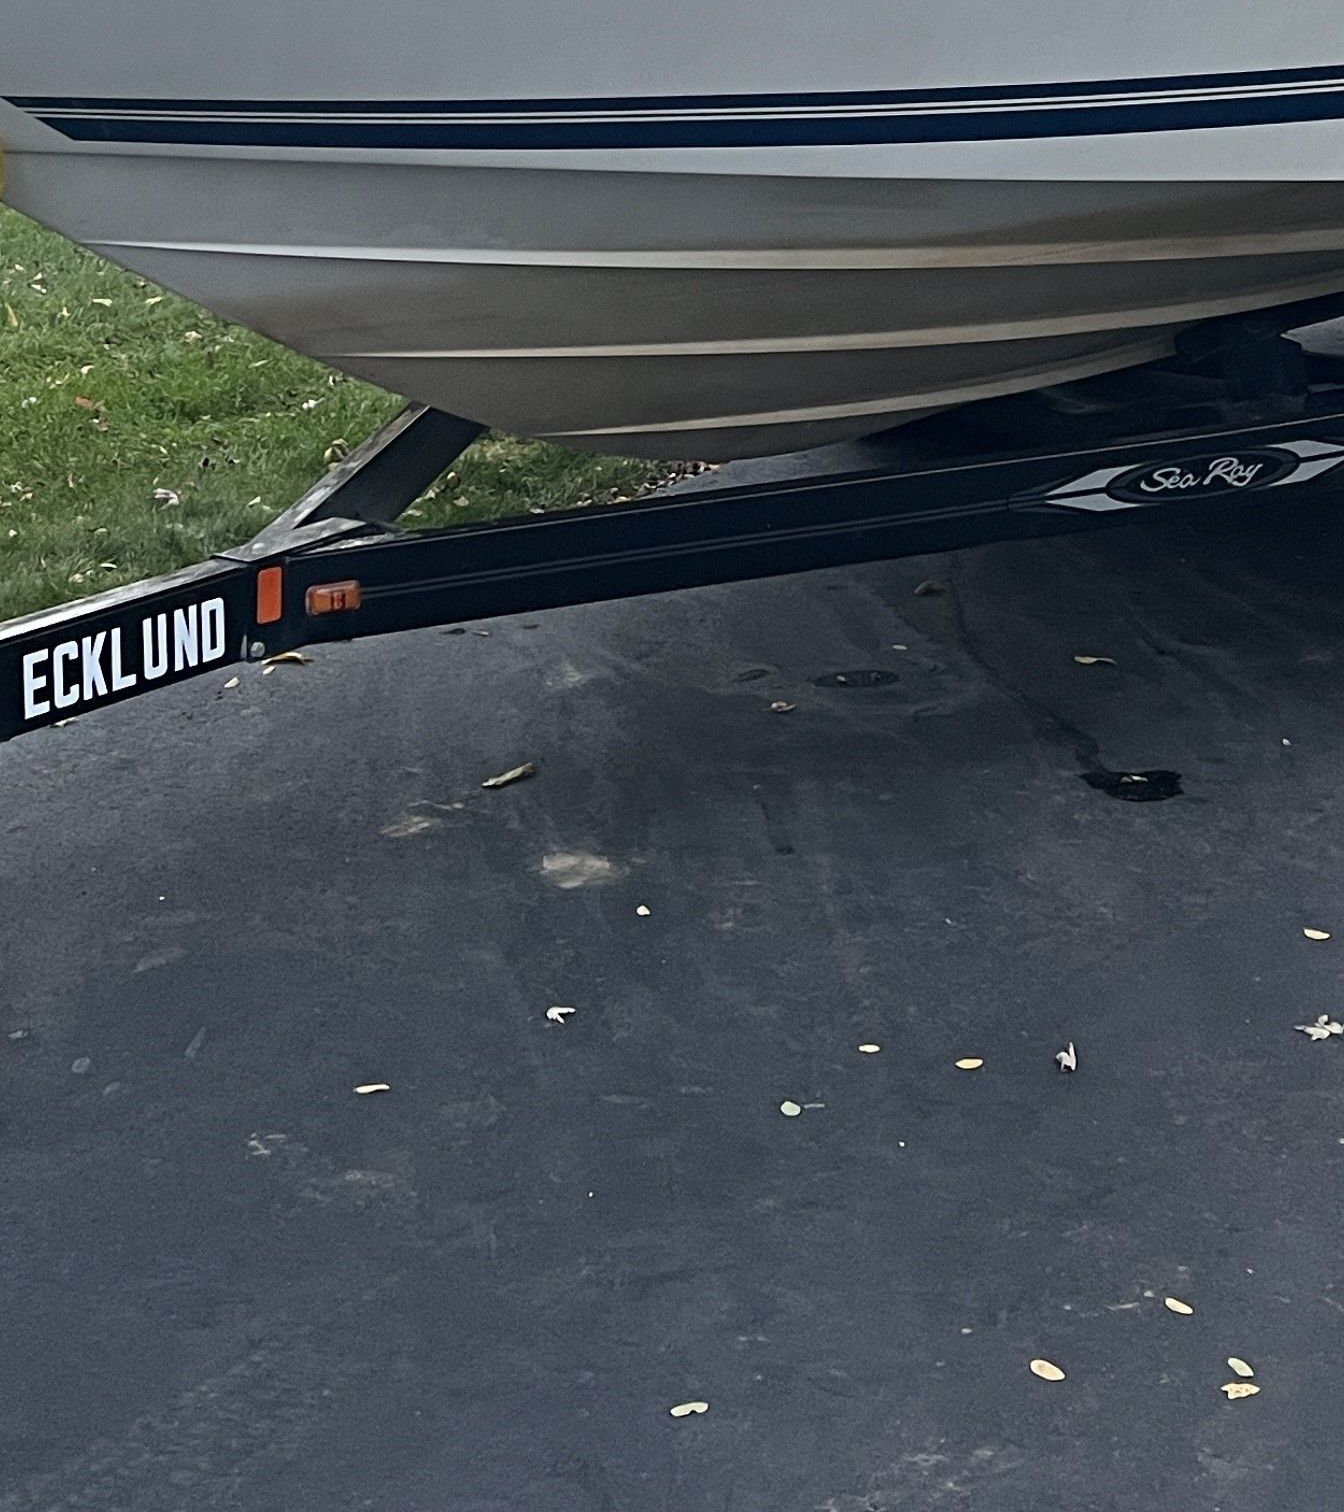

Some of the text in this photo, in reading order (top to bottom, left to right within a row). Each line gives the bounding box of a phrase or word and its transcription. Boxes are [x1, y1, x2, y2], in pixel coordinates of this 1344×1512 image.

[1140, 456, 1264, 492] Sea Ray
[23, 597, 224, 720] ECKLUND
